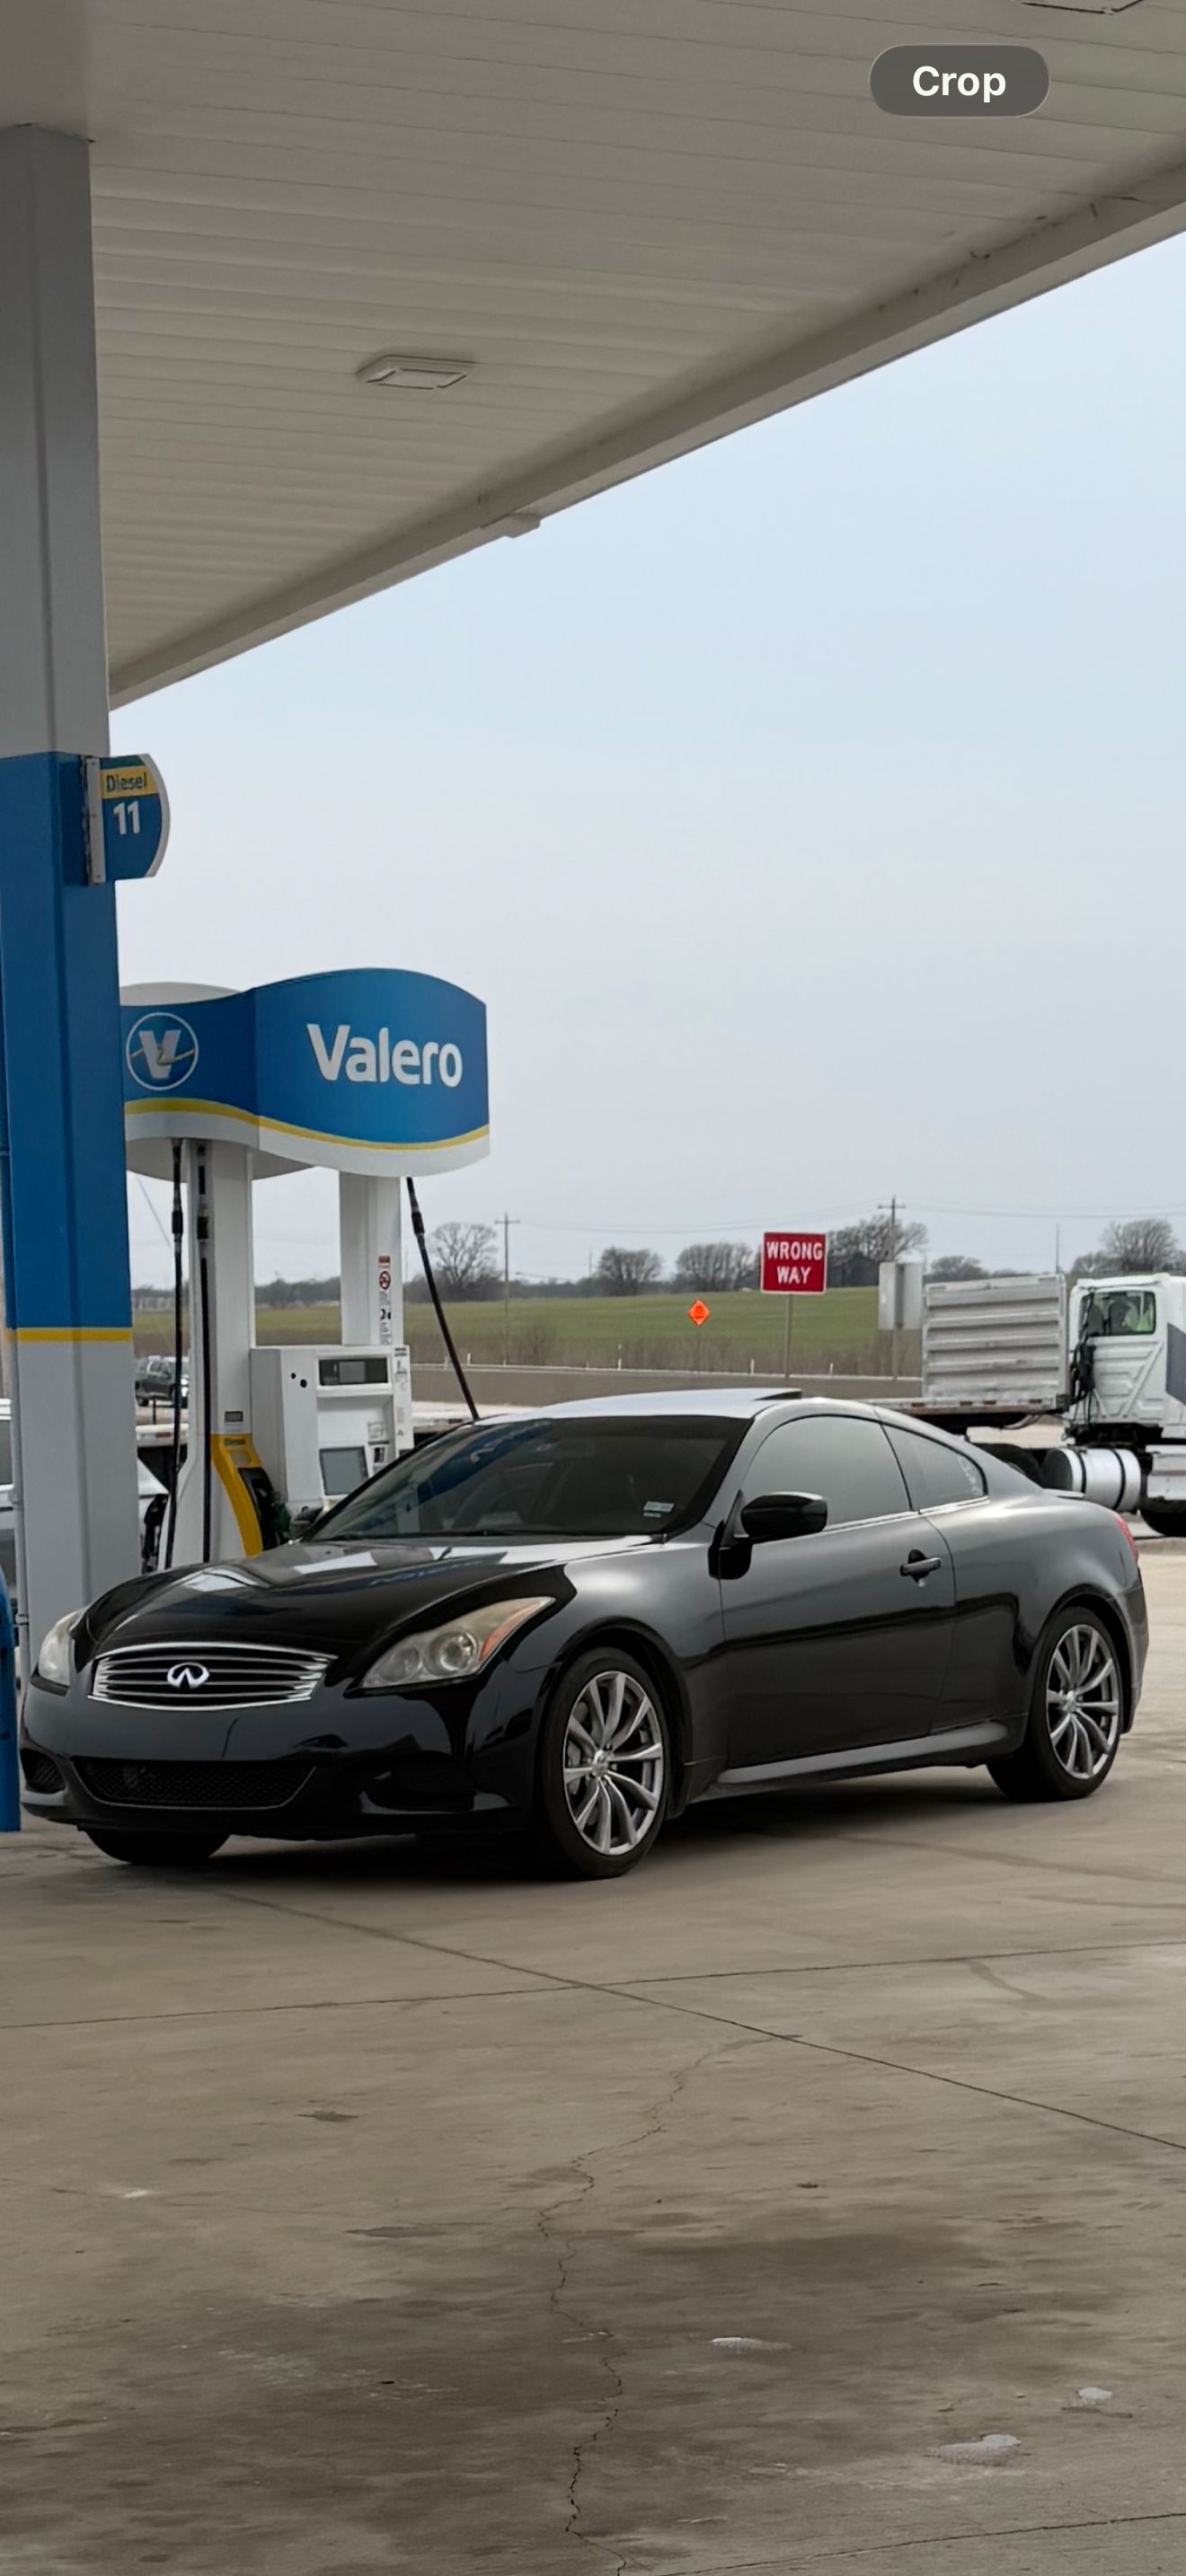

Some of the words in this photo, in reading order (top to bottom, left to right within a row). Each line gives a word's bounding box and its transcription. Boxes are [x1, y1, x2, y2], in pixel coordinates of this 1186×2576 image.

[106, 772, 147, 792] Diesel
[113, 800, 141, 835] 11
[306, 1023, 463, 1088] Valero
[766, 1241, 823, 1260] WRONG
[777, 1266, 811, 1284] WAY
